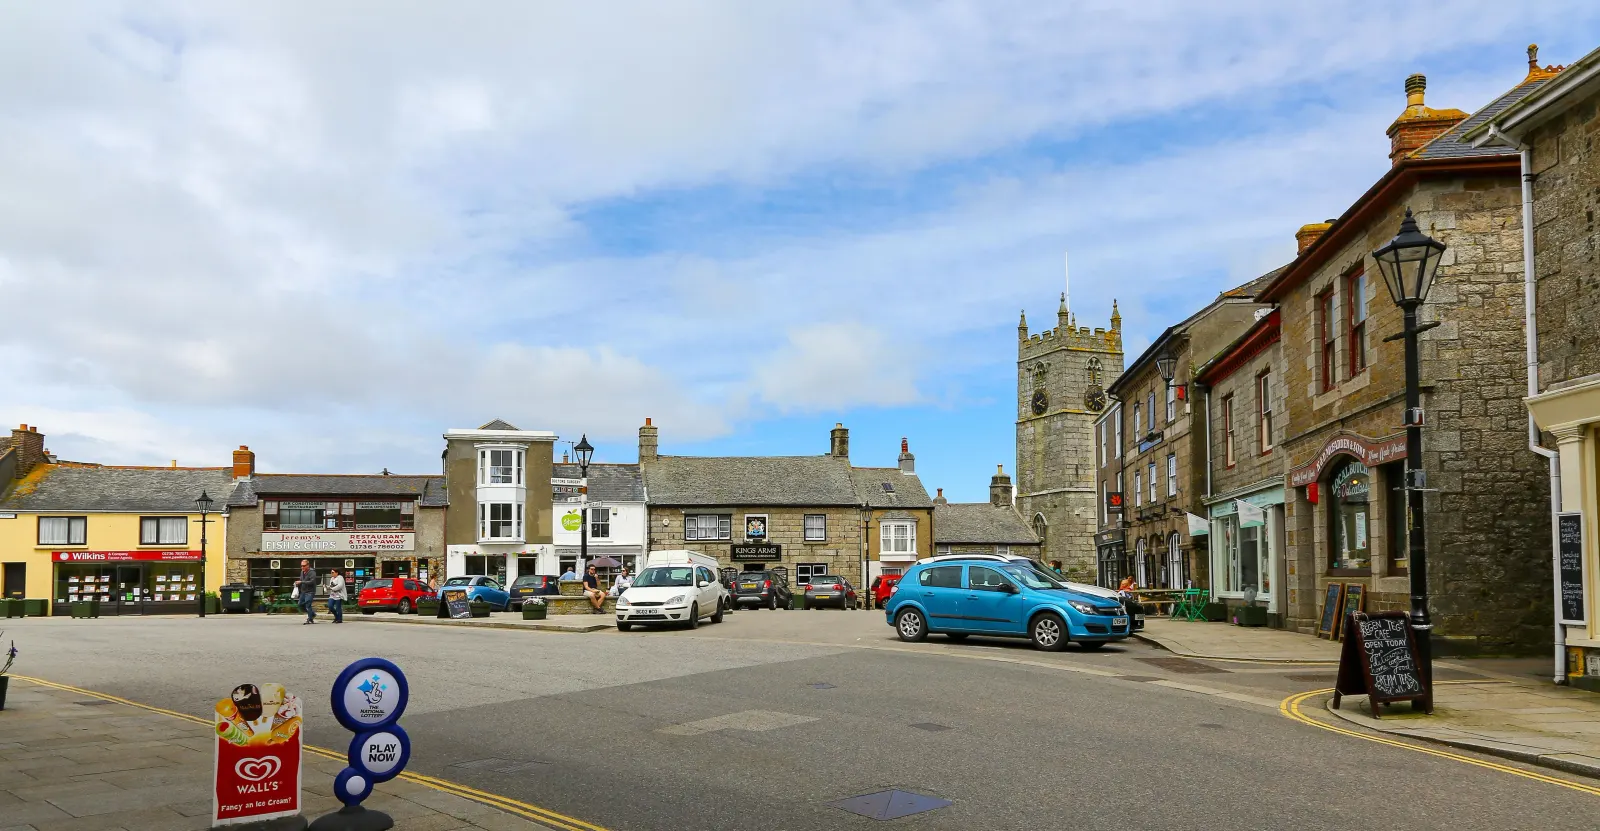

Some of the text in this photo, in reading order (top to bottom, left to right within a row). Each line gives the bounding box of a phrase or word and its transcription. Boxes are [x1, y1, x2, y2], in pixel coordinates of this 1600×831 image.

[1332, 467, 1350, 495] LOCAL
[266, 541, 337, 550] FISH & CHIPS
[1376, 673, 1412, 688] CREAM TEAS
[370, 744, 396, 753] PLAY
[369, 753, 395, 762] NOW
[237, 781, 279, 794] WALL'S
[268, 797, 291, 806] Cream?
